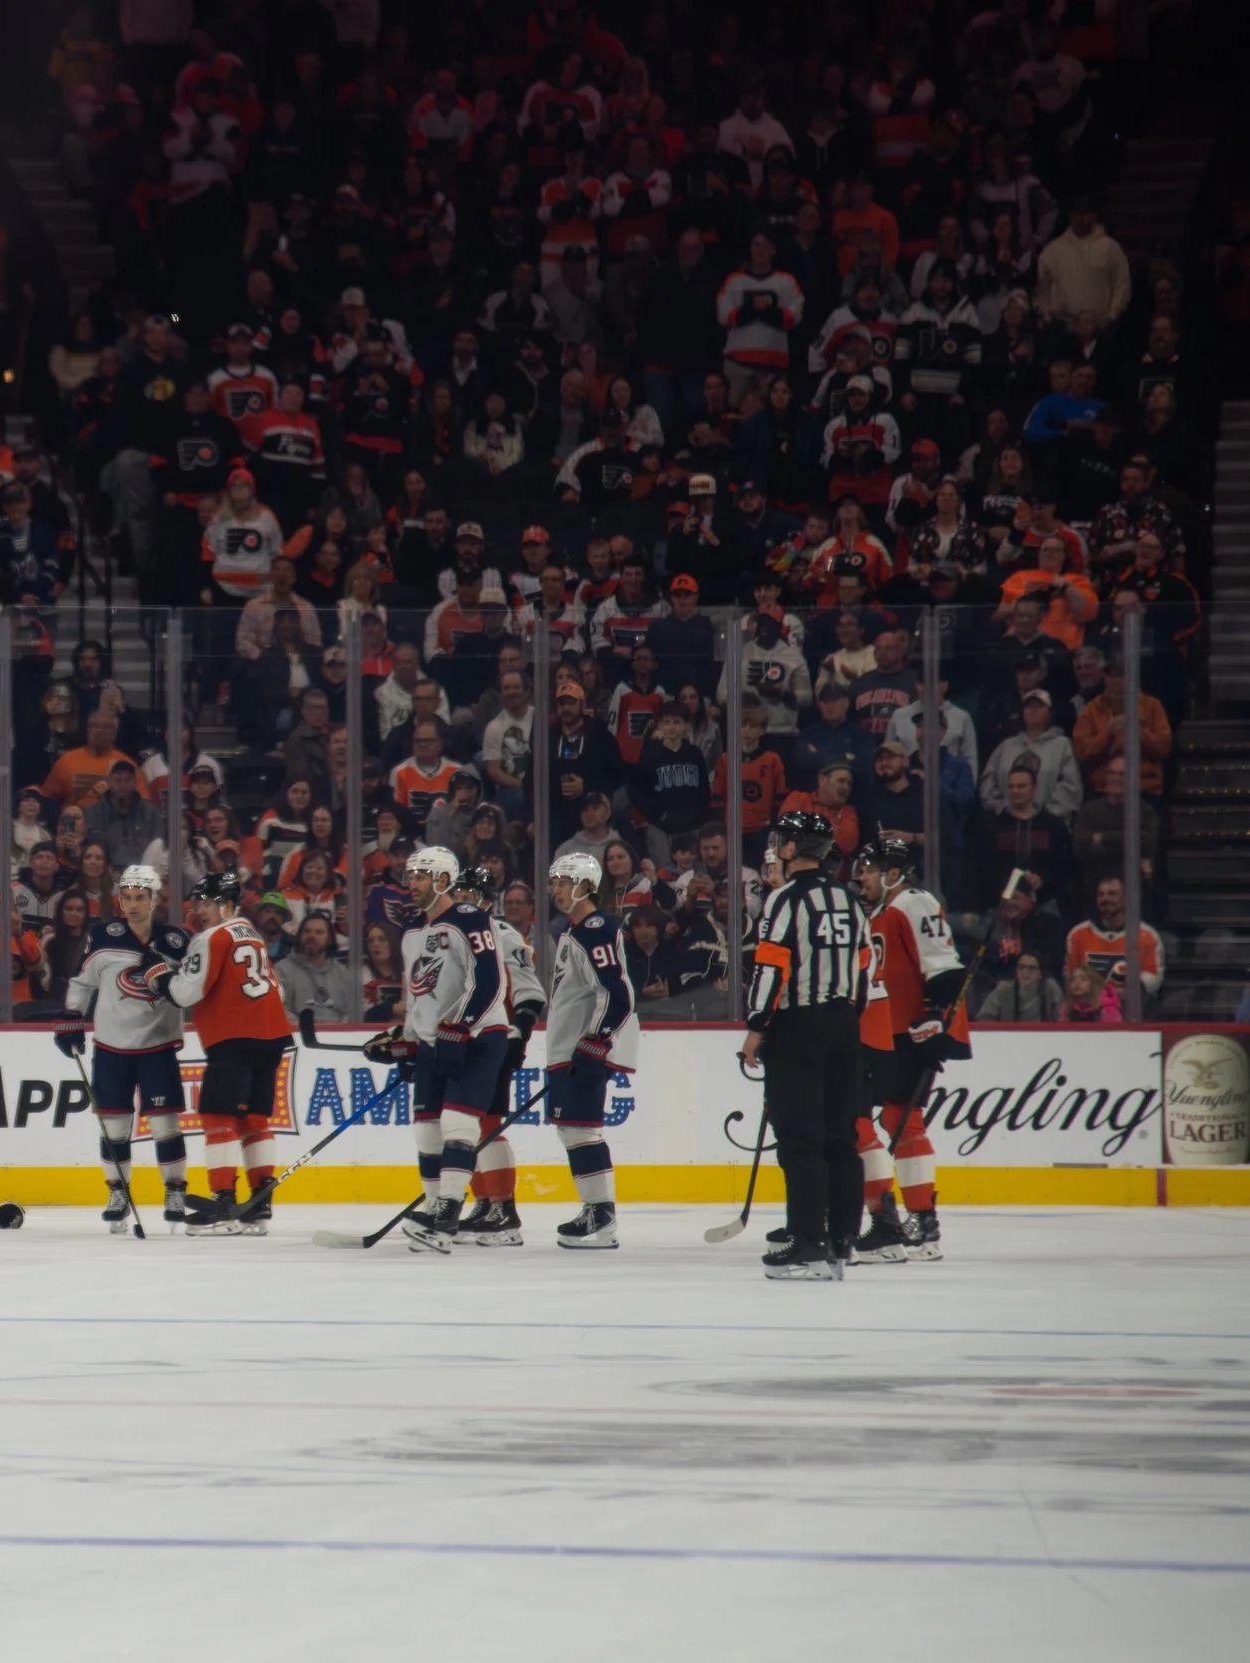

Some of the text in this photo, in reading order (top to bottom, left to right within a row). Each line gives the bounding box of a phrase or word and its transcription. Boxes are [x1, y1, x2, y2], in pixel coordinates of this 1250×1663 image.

[817, 913, 850, 945] 45
[921, 915, 946, 938] 47
[438, 931, 449, 950] C
[468, 931, 495, 954] 38
[593, 946, 618, 968] 91
[1170, 1120, 1246, 1143] LAGER
